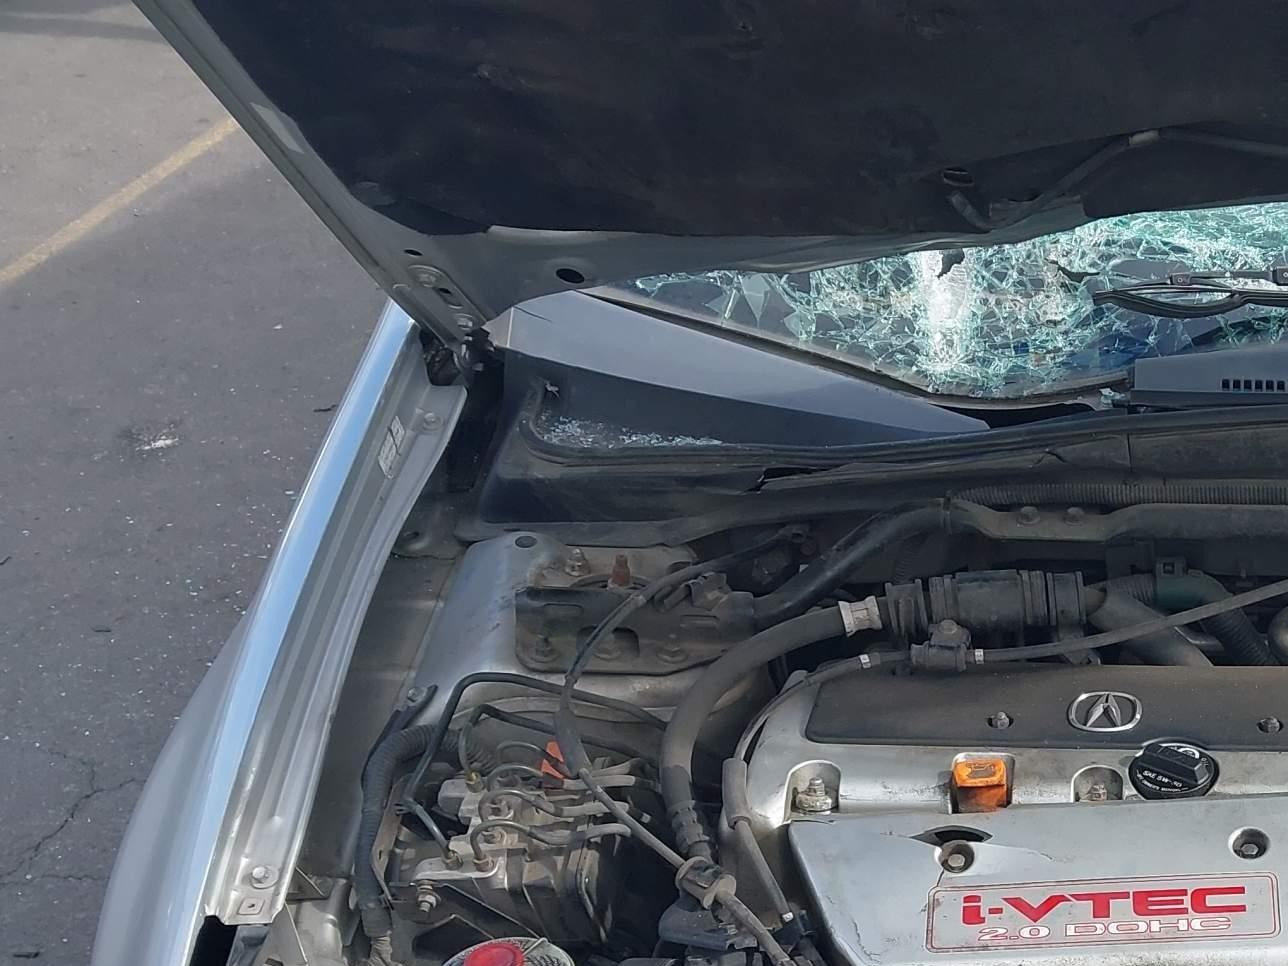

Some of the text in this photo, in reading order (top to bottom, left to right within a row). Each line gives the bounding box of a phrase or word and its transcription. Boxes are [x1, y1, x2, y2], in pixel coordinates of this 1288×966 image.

[1142, 770, 1157, 779] SAE
[962, 886, 1247, 926] i-VTEC
[977, 916, 1232, 942] 2.0 DOHC
